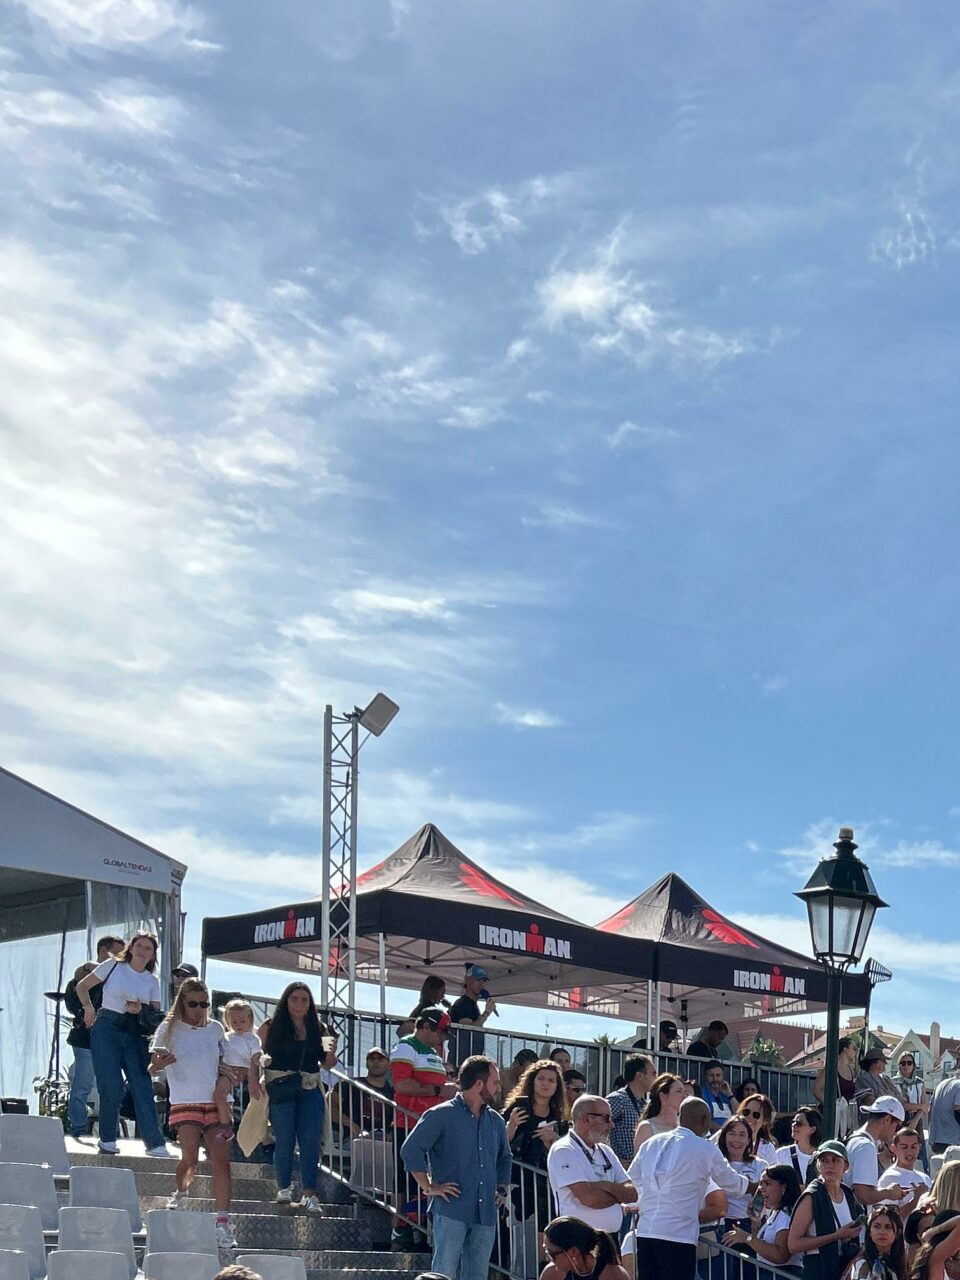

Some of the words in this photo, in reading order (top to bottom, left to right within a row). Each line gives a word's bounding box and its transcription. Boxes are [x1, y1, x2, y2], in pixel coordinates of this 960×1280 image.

[254, 909, 315, 943] IRONMAN
[479, 921, 571, 959] IRONMAN
[734, 966, 805, 995] IRONMAN
